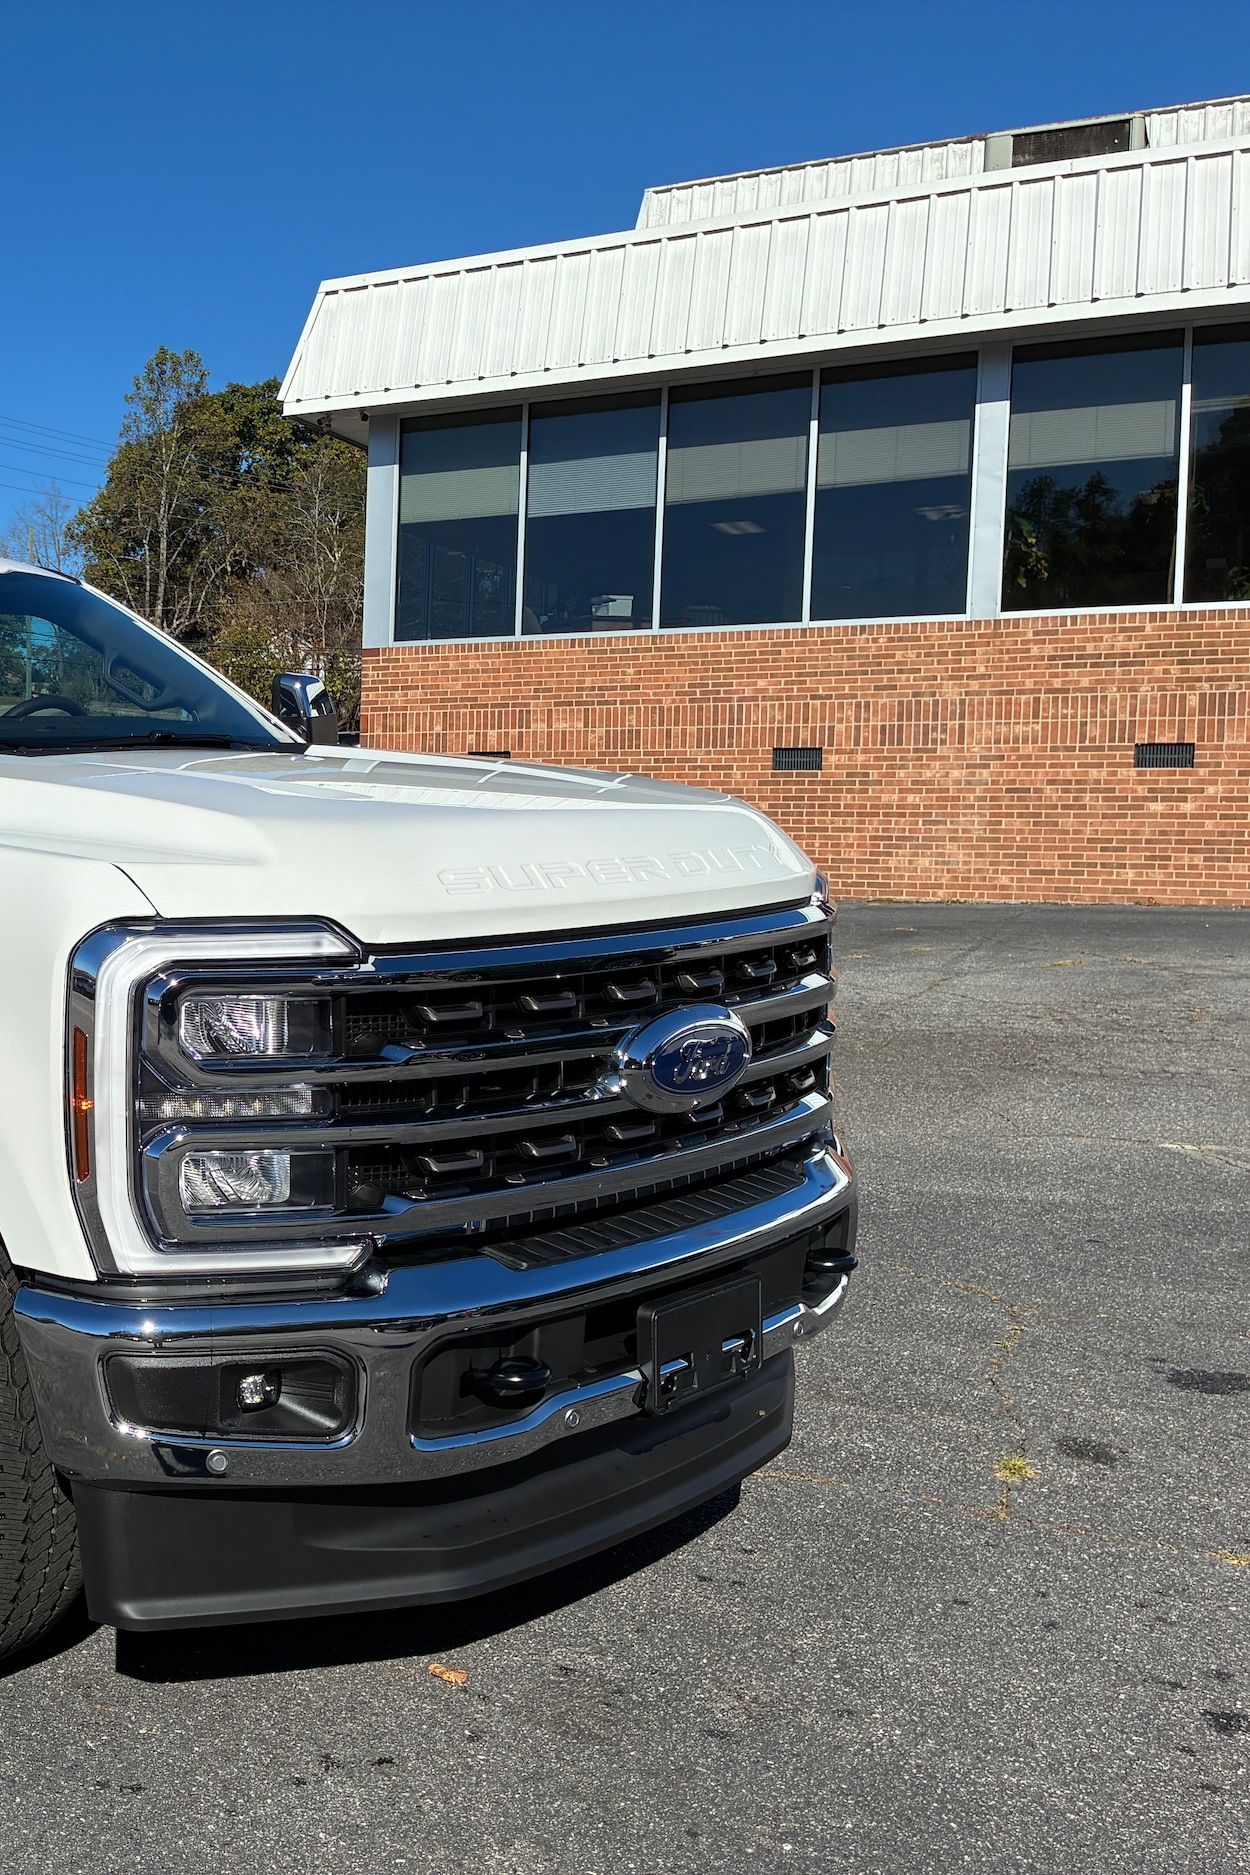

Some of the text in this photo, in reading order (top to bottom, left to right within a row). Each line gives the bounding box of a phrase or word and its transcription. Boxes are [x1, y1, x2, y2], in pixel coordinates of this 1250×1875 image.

[436, 844, 784, 896] SUPER DUTY
[673, 1037, 732, 1084] Ford
